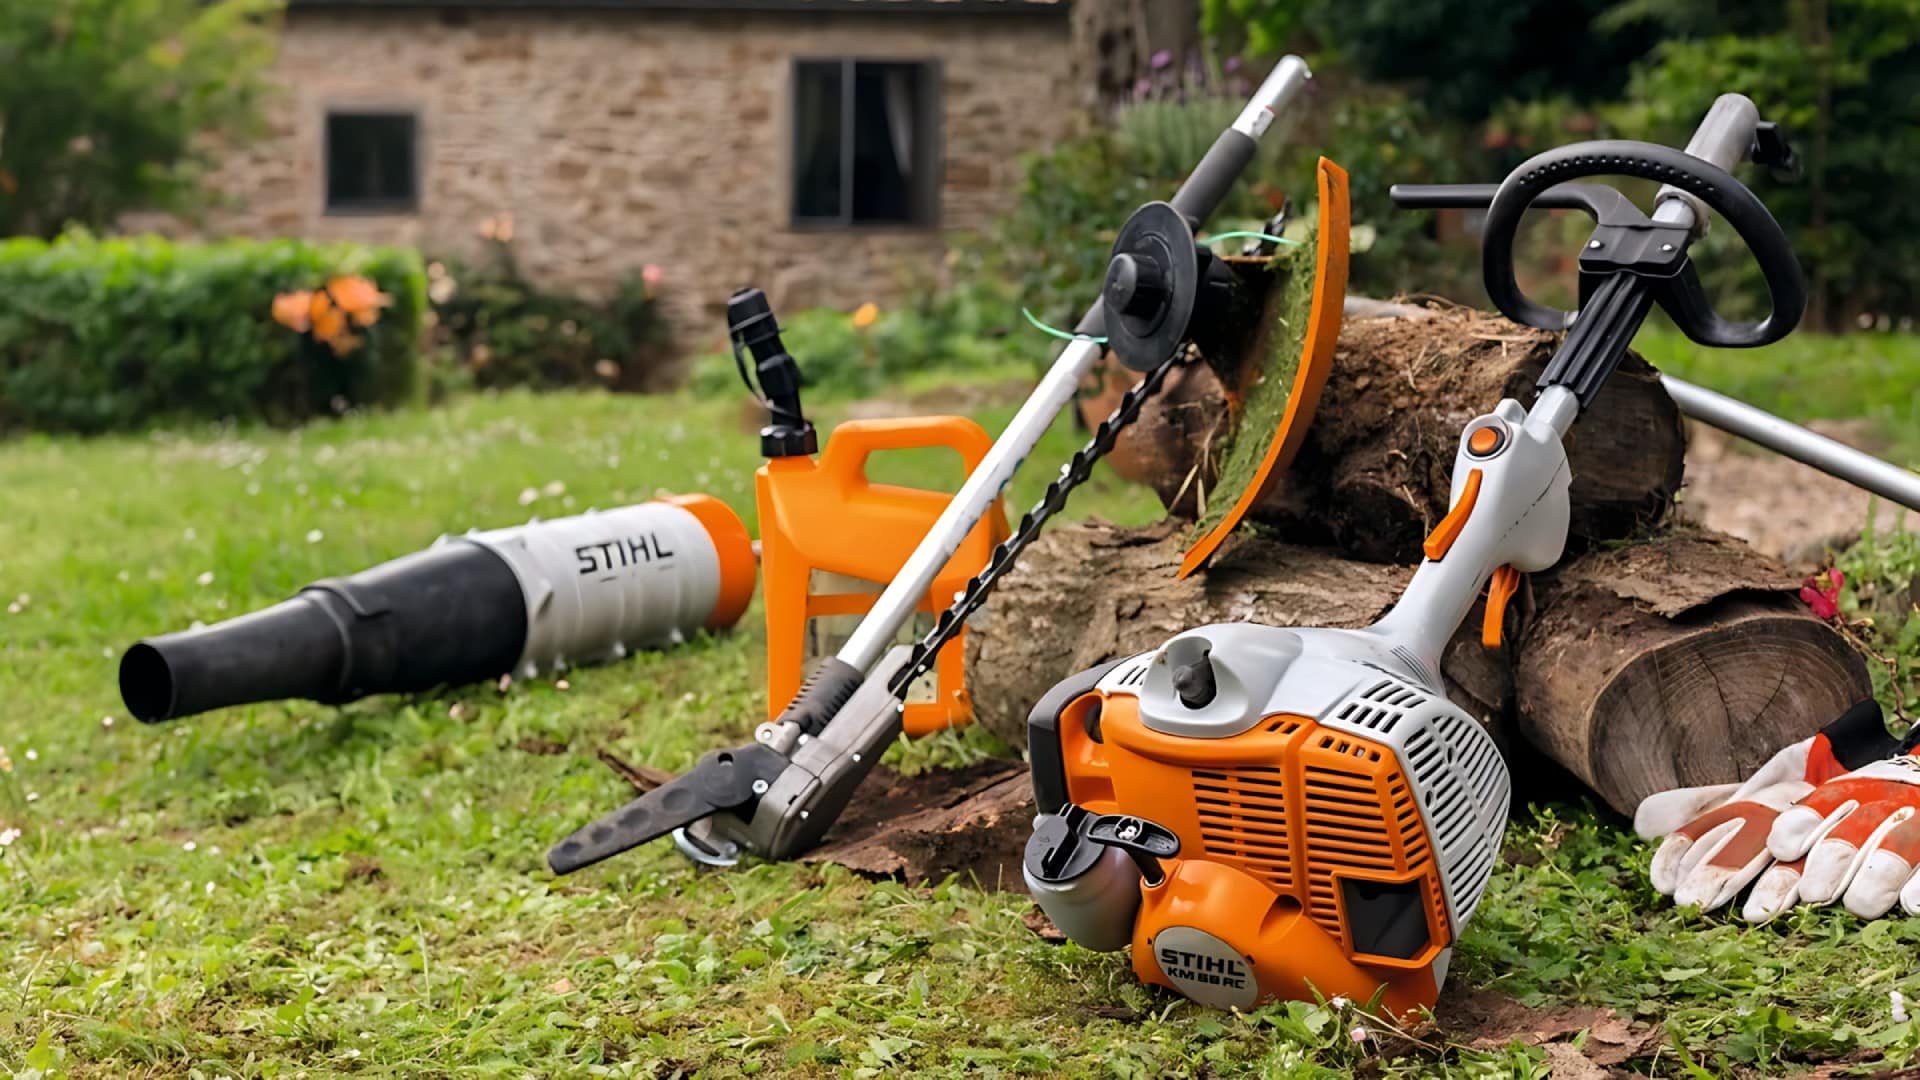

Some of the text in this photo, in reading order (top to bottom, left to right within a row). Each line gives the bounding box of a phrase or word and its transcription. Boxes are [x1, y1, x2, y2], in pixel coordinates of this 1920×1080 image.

[575, 532, 674, 574] STIHL
[1161, 948, 1246, 977] STIHL
[1167, 967, 1195, 981] KM
[1222, 977, 1245, 990] RC
